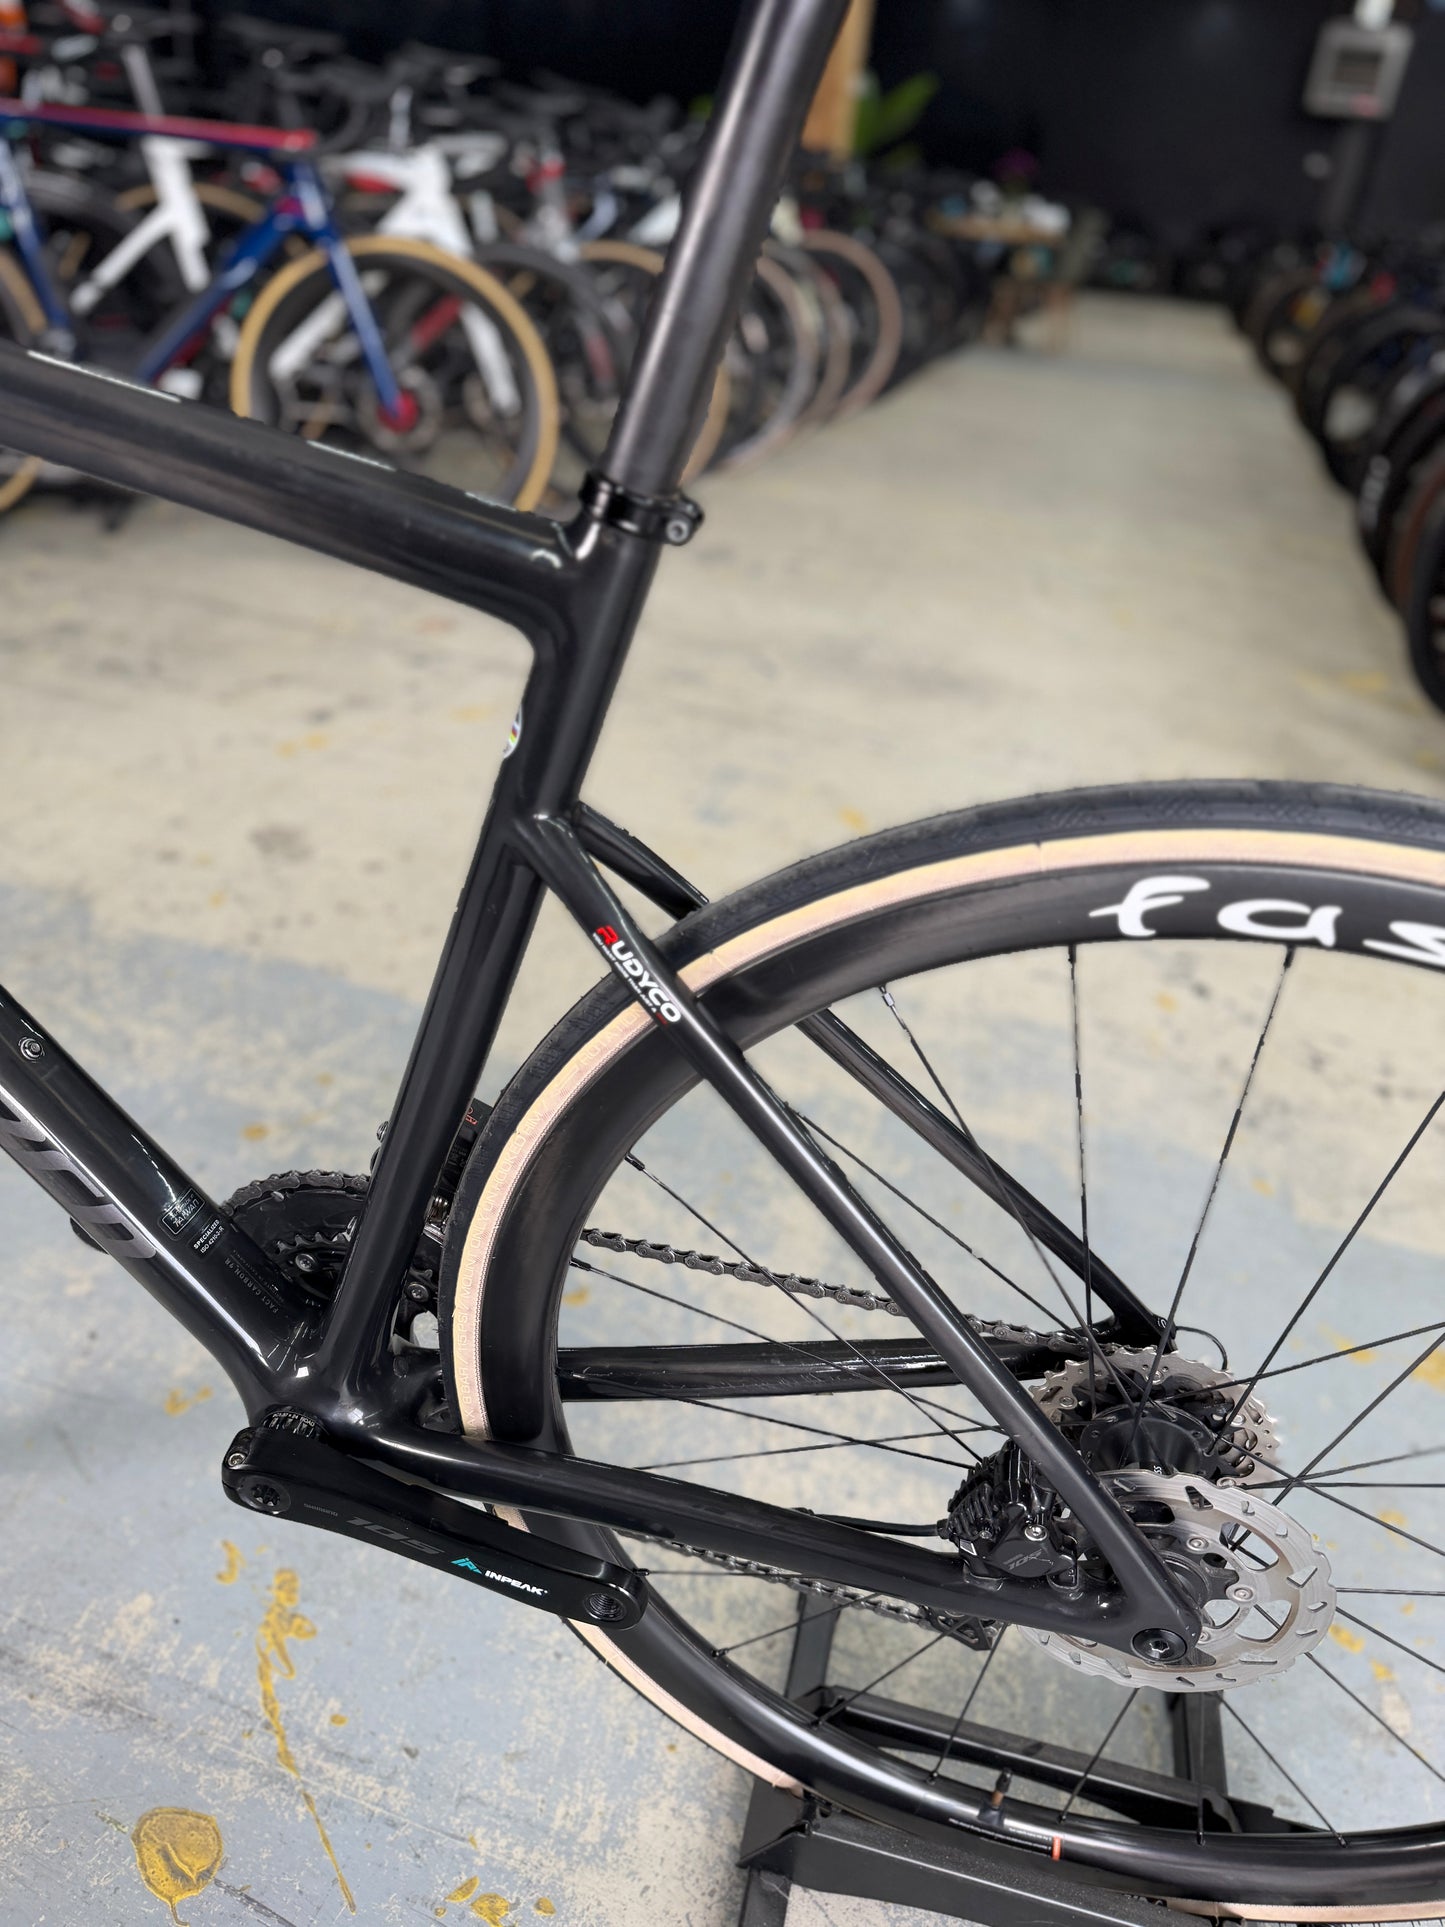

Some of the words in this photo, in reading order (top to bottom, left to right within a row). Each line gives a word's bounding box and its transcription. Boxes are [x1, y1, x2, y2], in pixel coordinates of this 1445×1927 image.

[596, 925, 681, 1022] RUDYCO
[193, 1219, 220, 1250] SPECIALIZED
[200, 1243, 210, 1253] ISO
[234, 1268, 261, 1296] CARBON
[457, 1311, 467, 1332] PSI
[458, 1366, 470, 1392] BAR
[347, 1517, 445, 1554] 105
[485, 1570, 546, 1596] INPEAK
